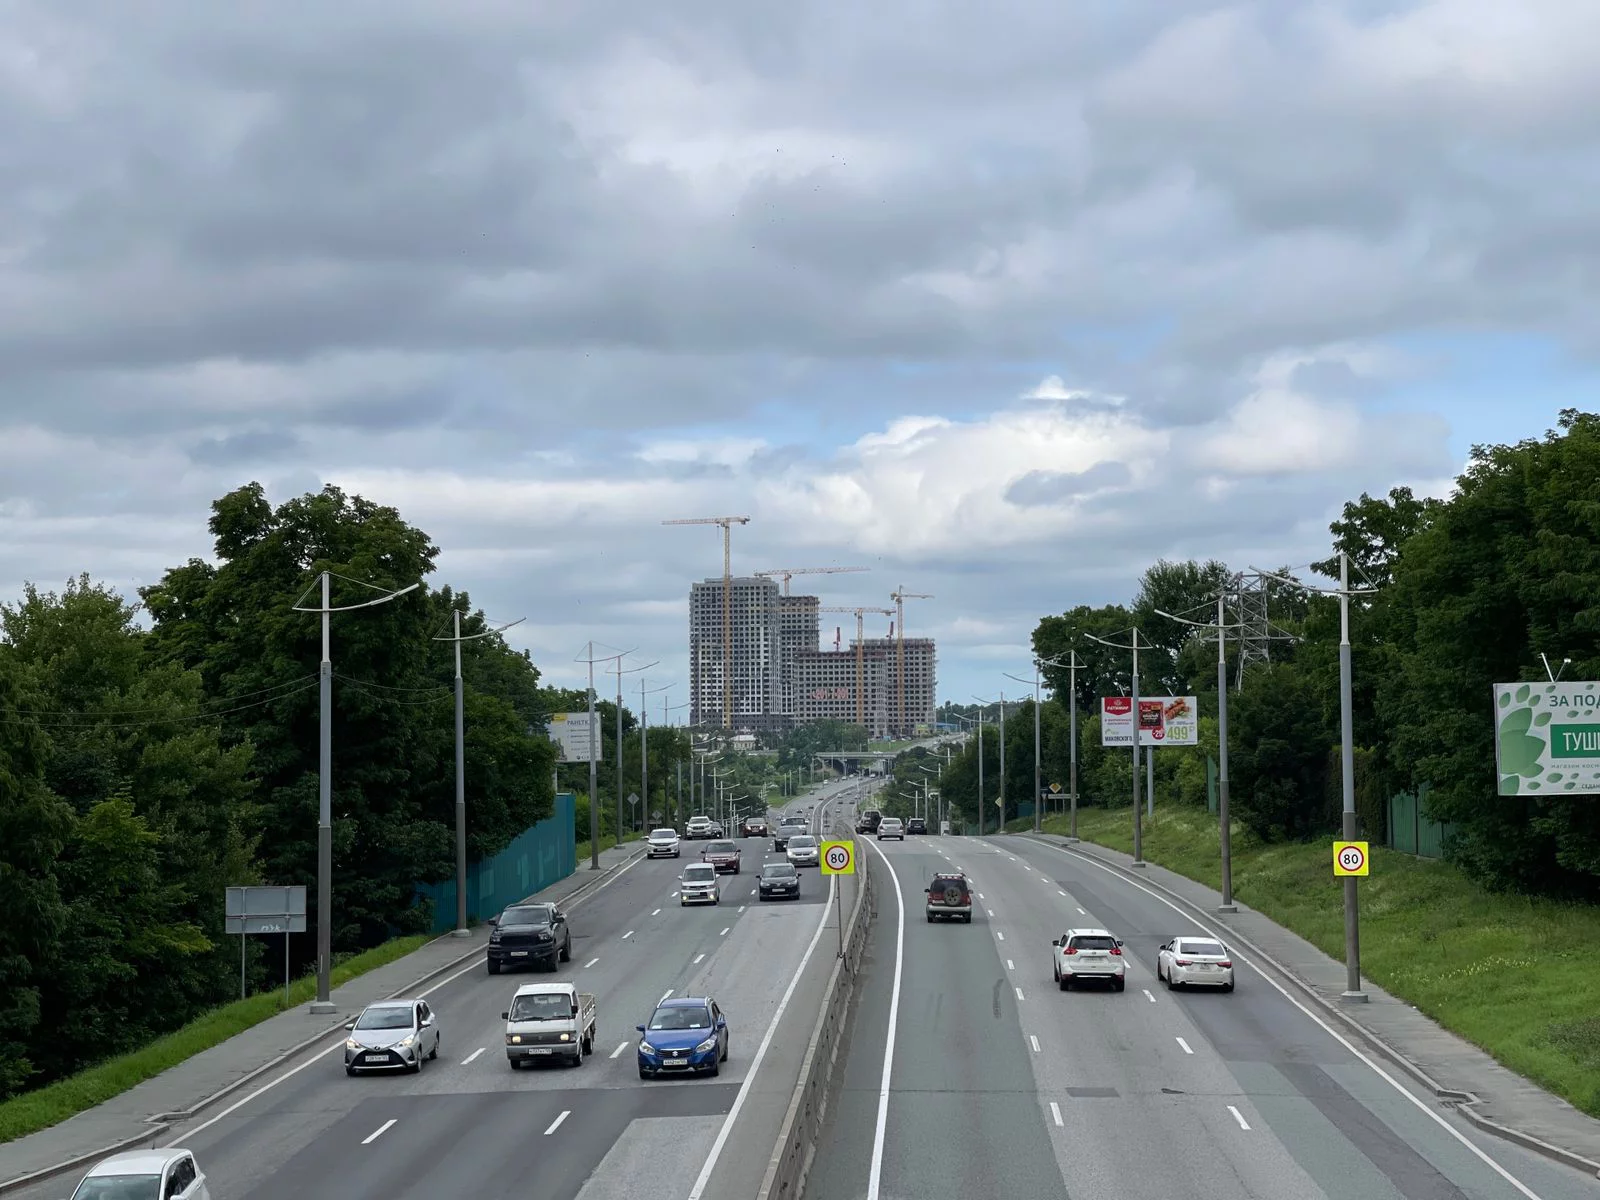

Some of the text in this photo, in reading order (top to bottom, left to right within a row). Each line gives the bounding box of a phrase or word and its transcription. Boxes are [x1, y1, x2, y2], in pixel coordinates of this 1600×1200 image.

[1549, 695, 1569, 707] ЗА
[1167, 726, 1188, 740] 499
[1562, 732, 1600, 751] ТУШ
[830, 853, 845, 864] 80
[1343, 853, 1359, 865] 80
